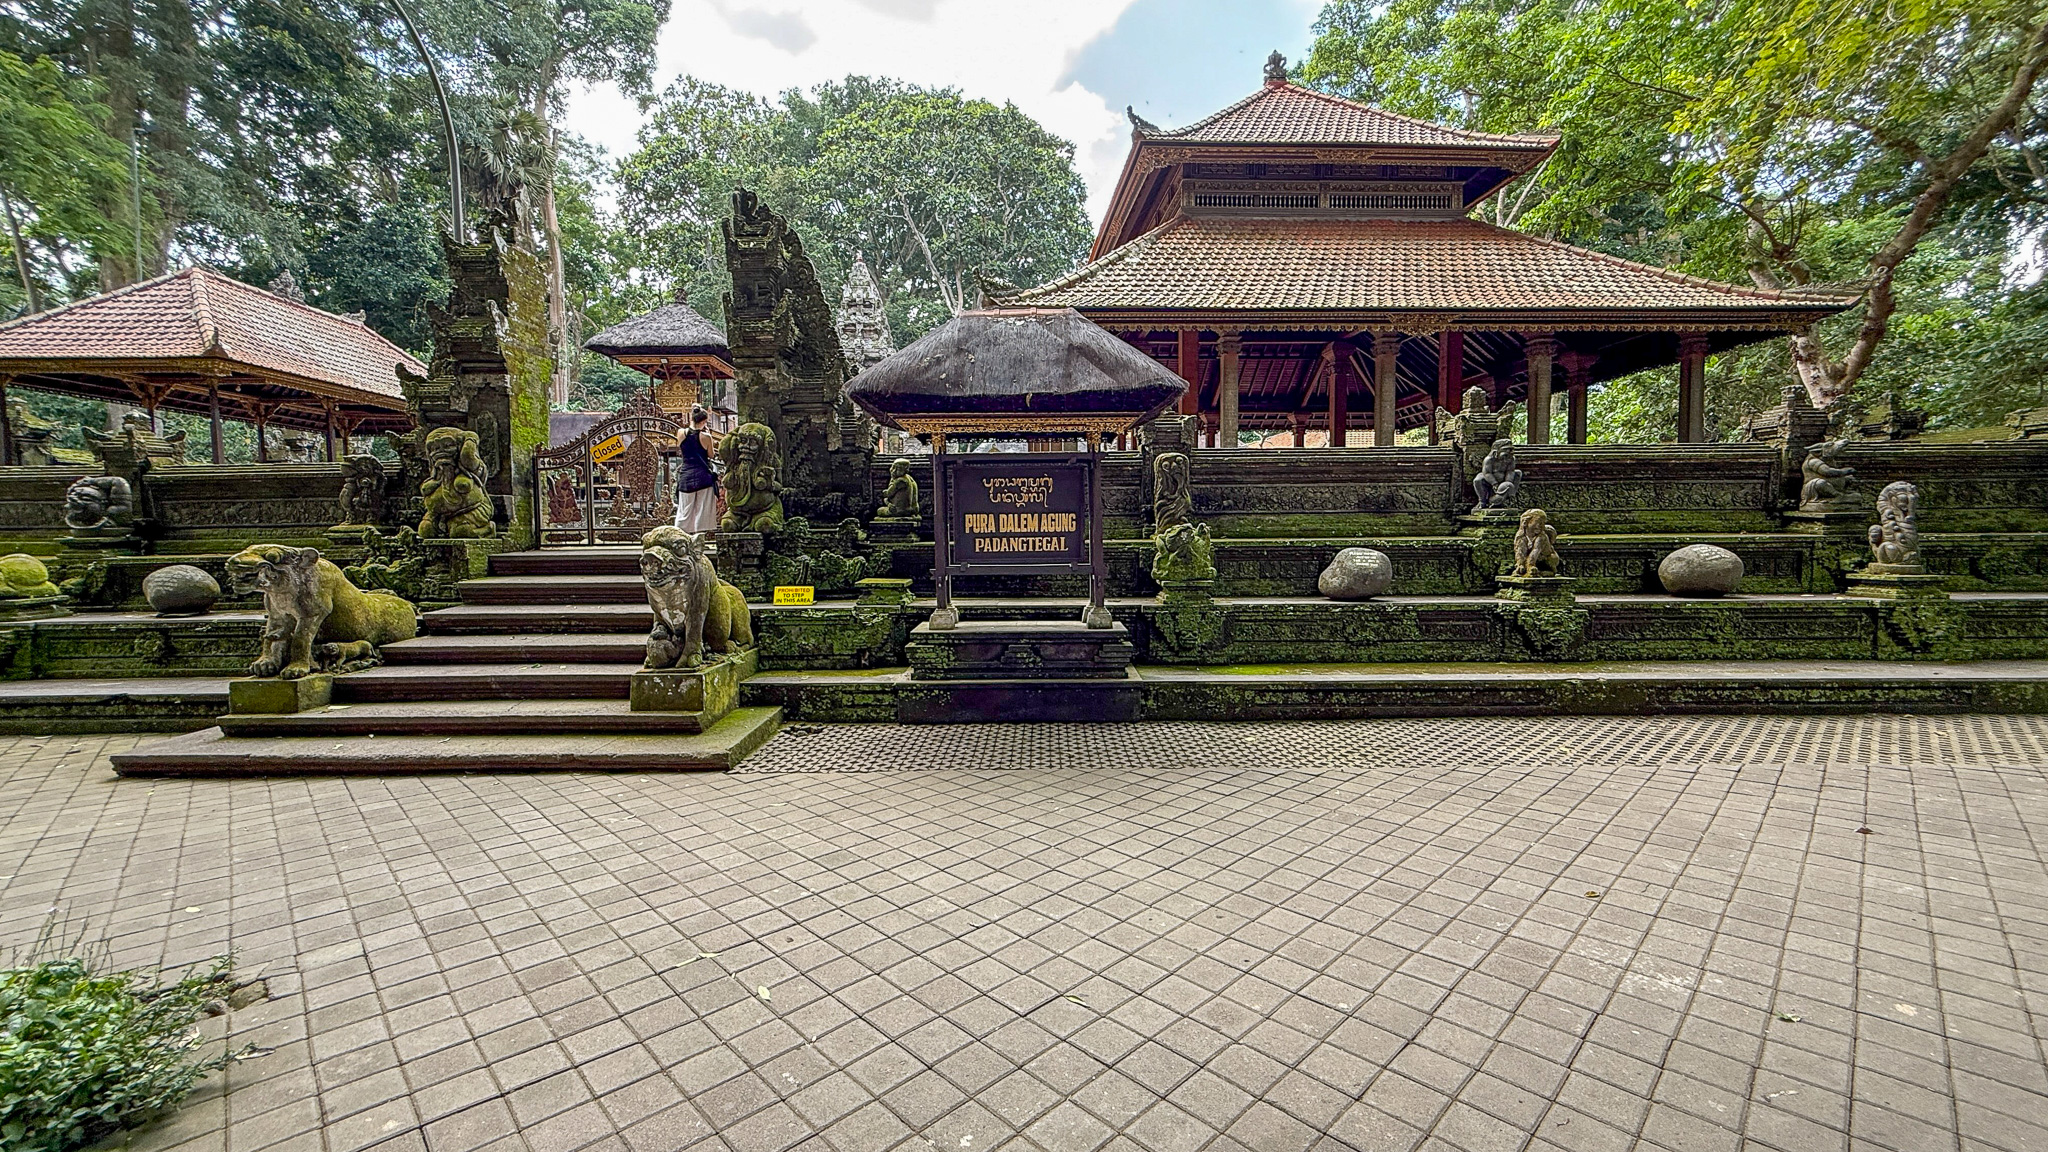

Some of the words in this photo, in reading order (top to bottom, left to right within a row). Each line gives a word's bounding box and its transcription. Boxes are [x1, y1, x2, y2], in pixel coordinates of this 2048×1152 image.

[593, 438, 623, 459] Closed
[965, 513, 996, 534] PURA
[999, 513, 1039, 533] DALEM
[1040, 513, 1077, 532] AGUNG
[975, 536, 1069, 553] PADANGTEGAL
